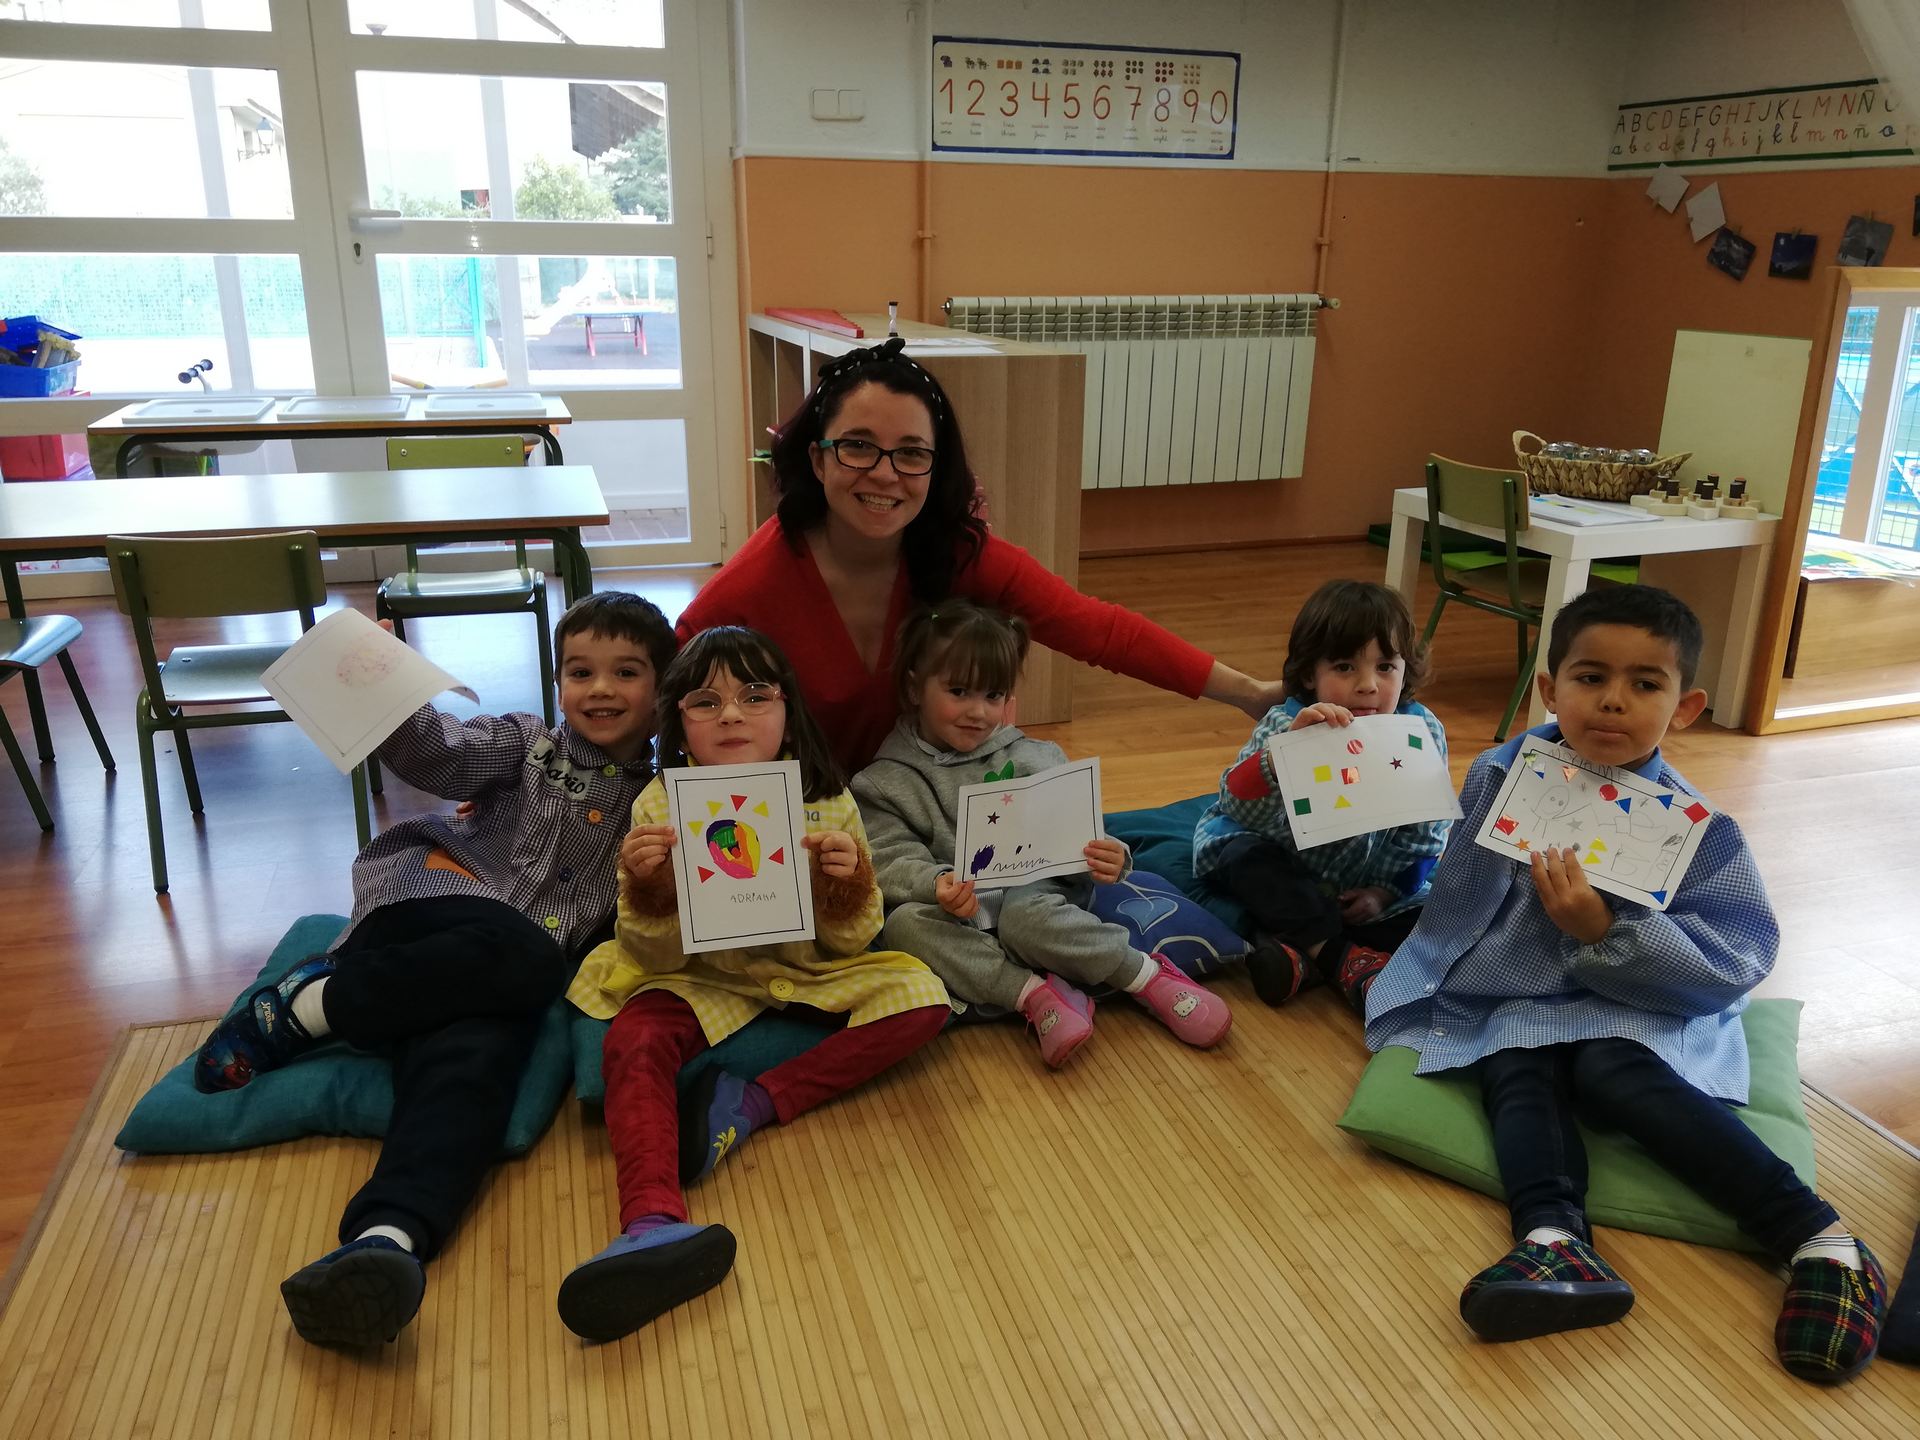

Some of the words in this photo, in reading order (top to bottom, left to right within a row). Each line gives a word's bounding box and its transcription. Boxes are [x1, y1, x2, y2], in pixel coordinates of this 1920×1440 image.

[940, 78, 953, 114] 1
[967, 79, 985, 115] 2
[1000, 81, 1018, 116] 3
[1033, 82, 1050, 118] 4
[1064, 83, 1080, 119] 5
[1093, 85, 1111, 119] 6
[1125, 86, 1142, 120] 7
[1154, 88, 1171, 122] 8
[1183, 89, 1199, 122] 9
[1210, 90, 1228, 124] 0
[533, 748, 586, 794] Mario
